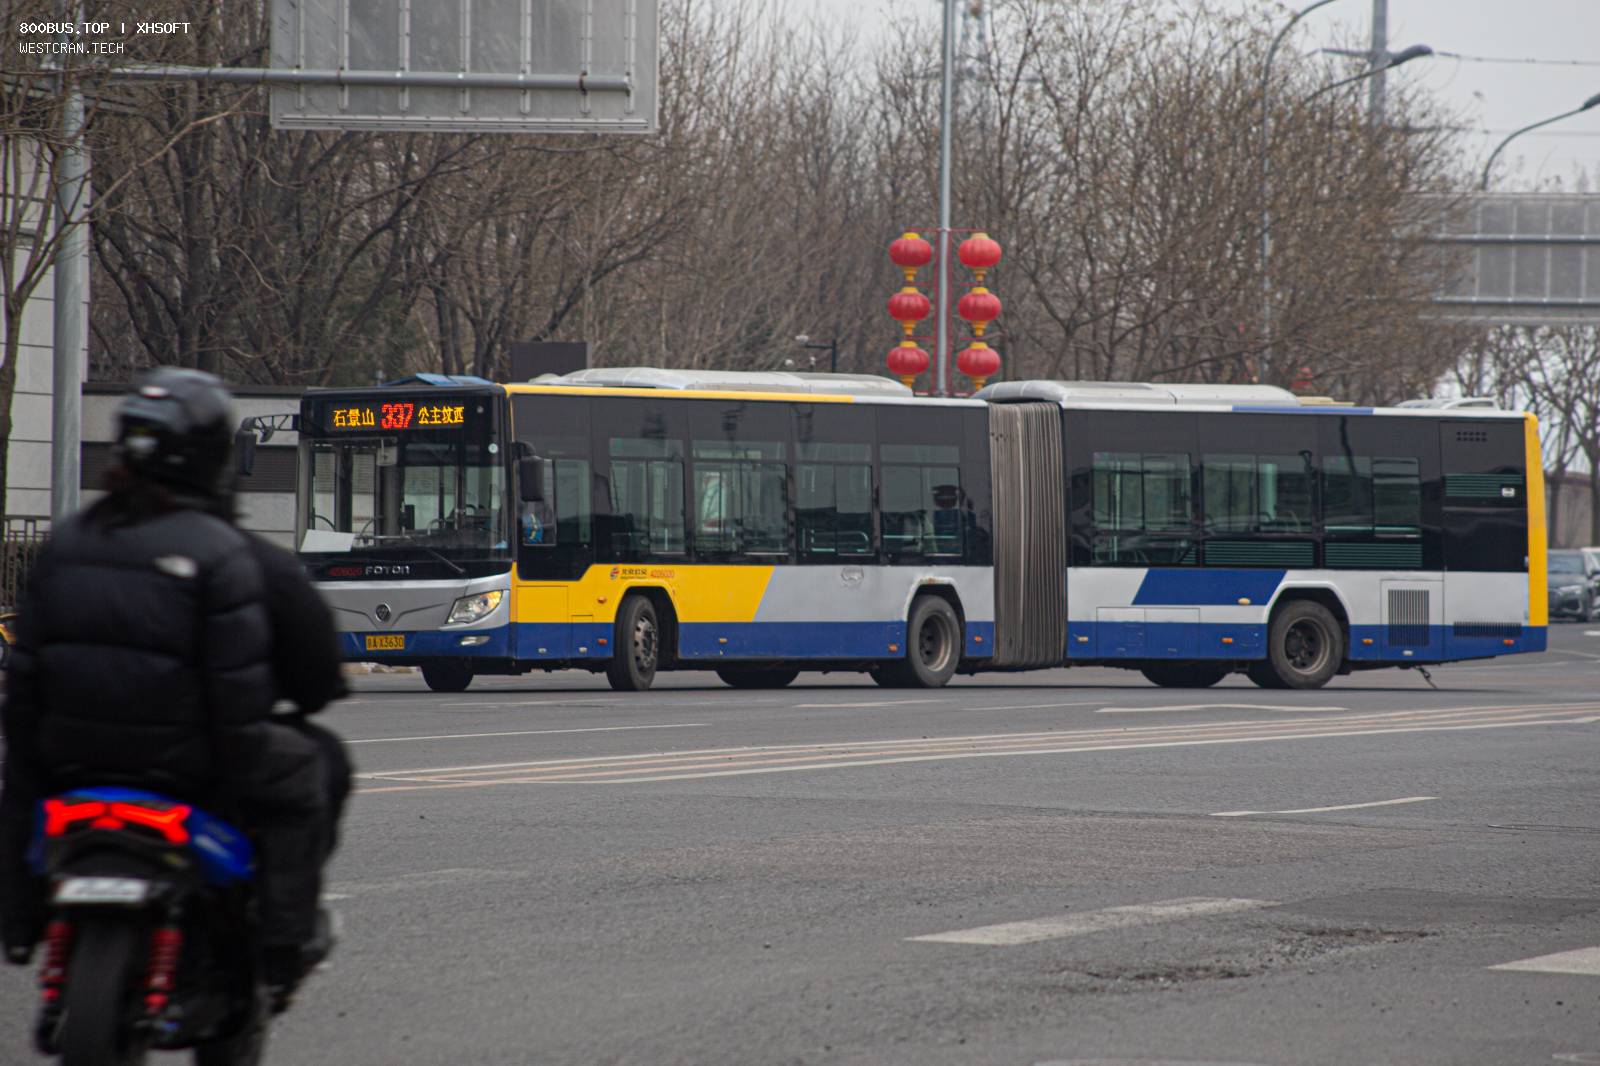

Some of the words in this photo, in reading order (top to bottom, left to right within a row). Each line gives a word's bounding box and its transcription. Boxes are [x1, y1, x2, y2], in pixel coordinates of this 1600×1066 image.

[333, 408, 375, 427] 石景山
[381, 403, 414, 429] 337
[417, 406, 465, 425] 公主坟西
[365, 565, 411, 576] FOTON
